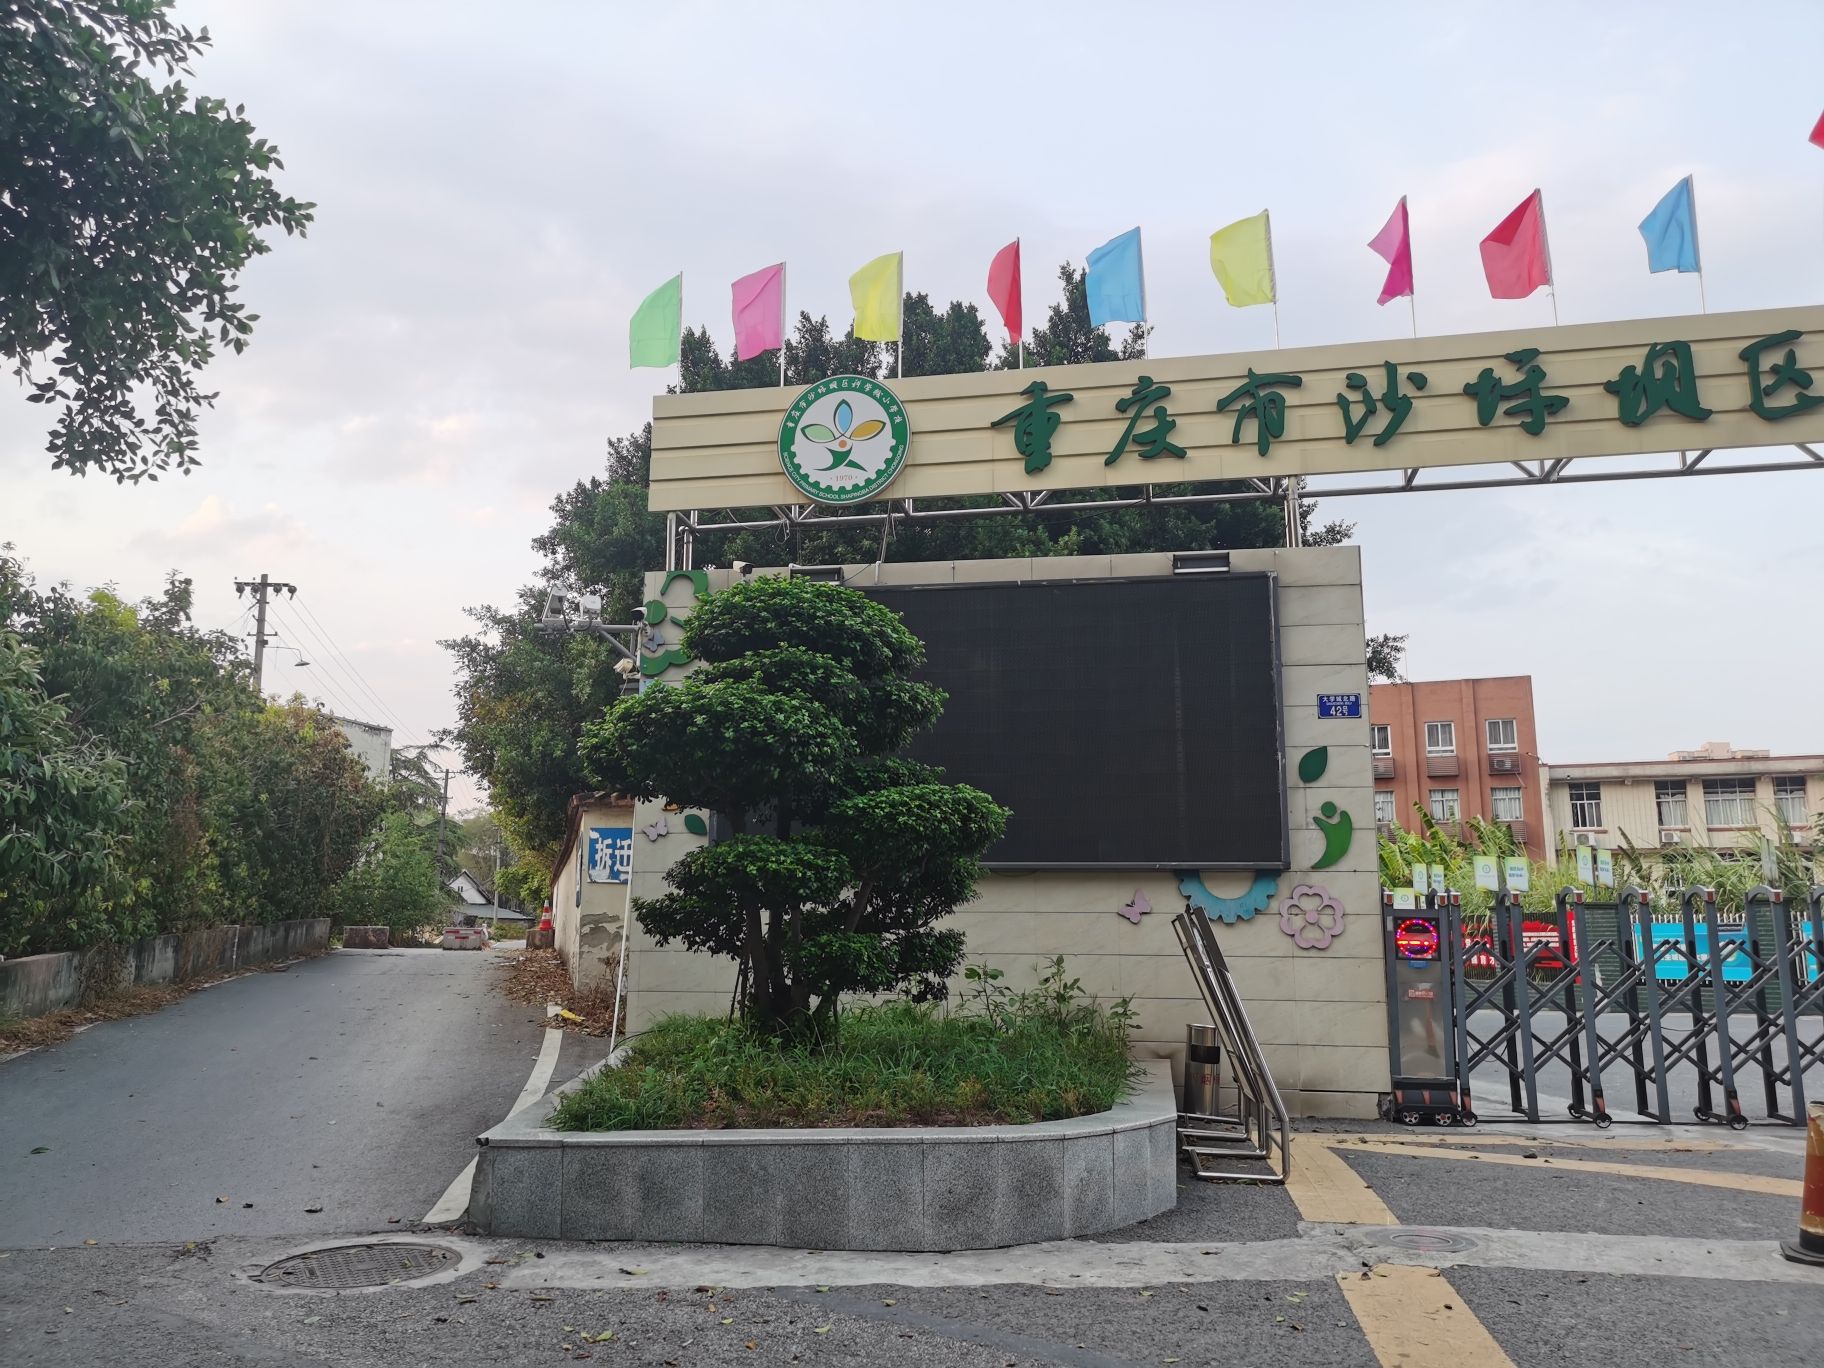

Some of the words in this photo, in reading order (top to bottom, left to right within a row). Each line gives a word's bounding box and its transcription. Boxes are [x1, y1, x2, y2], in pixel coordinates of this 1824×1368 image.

[990, 329, 1824, 475] 重庆市沙坪坝区
[1330, 706, 1348, 716] 42号
[595, 837, 632, 872] 拆迁
